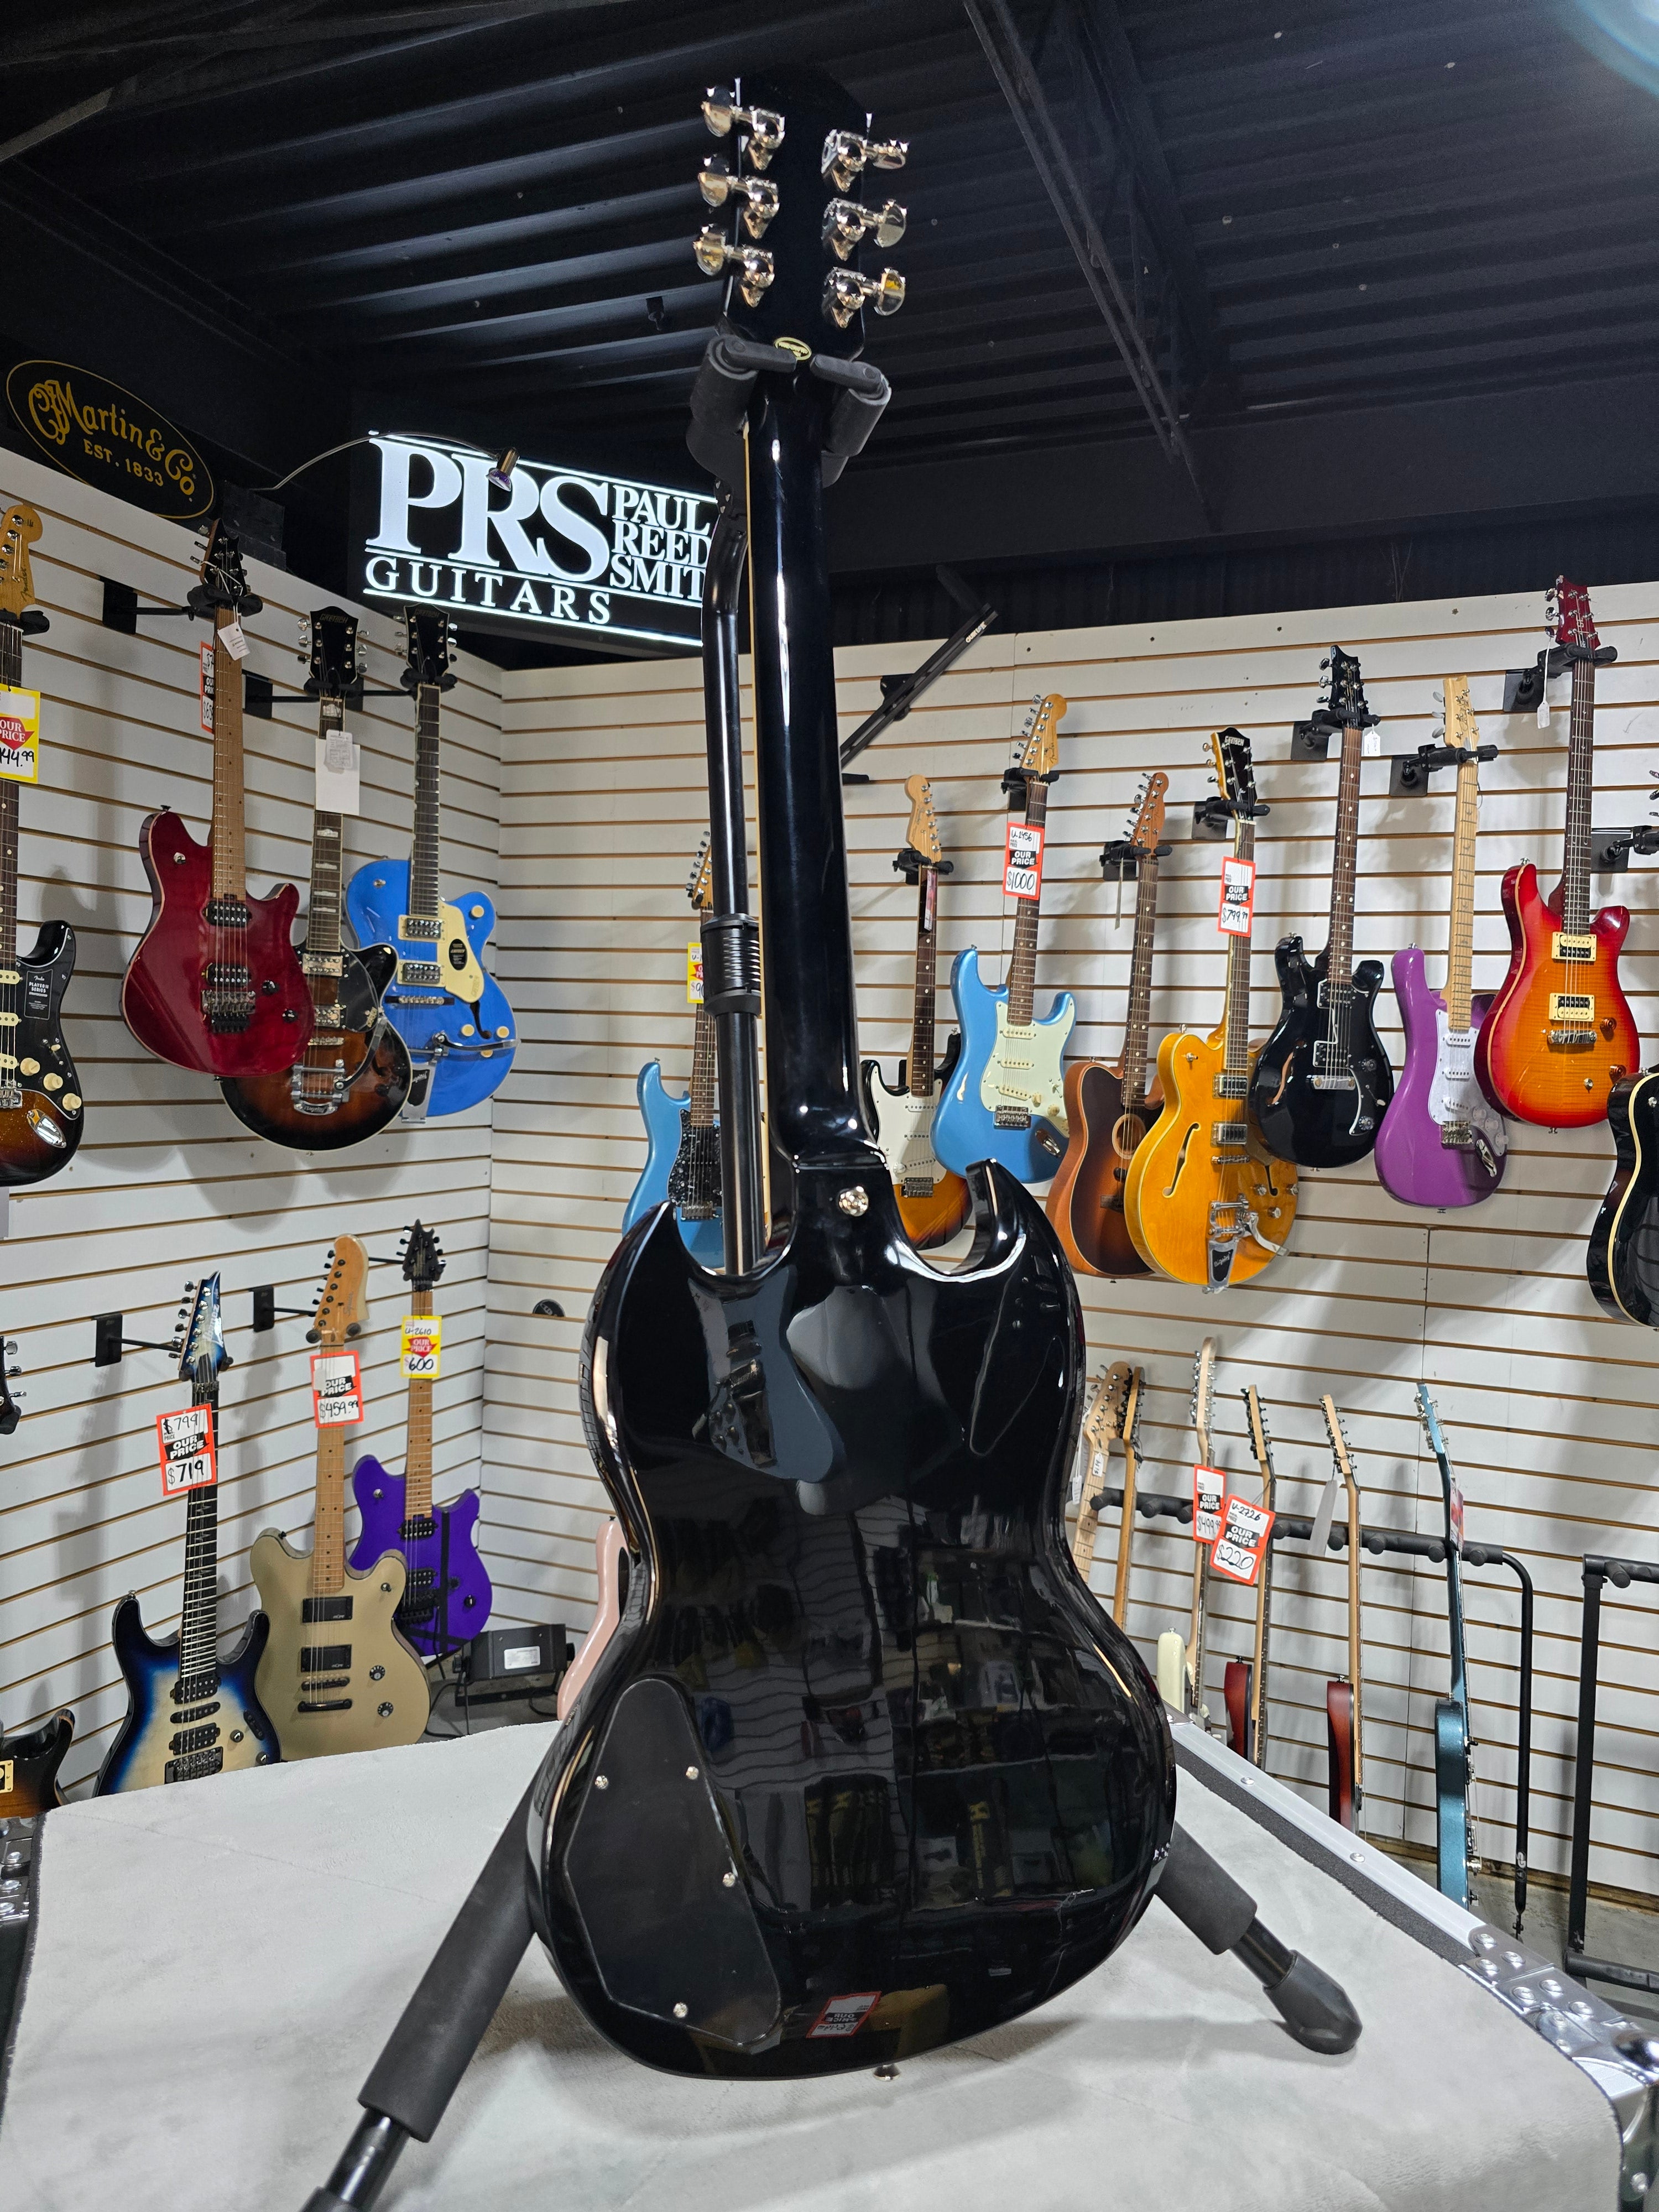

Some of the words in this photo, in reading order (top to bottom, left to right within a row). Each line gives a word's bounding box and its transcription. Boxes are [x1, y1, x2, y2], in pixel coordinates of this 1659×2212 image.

[126, 458, 164, 487] 1833
[366, 438, 609, 582] PRS
[612, 484, 710, 536] PAUL
[611, 519, 712, 568] REED
[609, 554, 706, 601] SMIT
[366, 556, 610, 625] GUITARS
[0, 719, 22, 732] OUR
[1007, 870, 1035, 890] $1000
[1225, 893, 1248, 901] PRICE
[322, 1382, 352, 1396] PRICE
[325, 1377, 346, 1389] OUR
[170, 1440, 204, 1460] PRICE
[173, 1435, 197, 1450] OUR
[168, 1459, 204, 1485] $719
[1199, 1501, 1220, 1510] PRICE
[1225, 1532, 1257, 1547] PRICE
[1230, 1526, 1253, 1538] OUR
[1216, 1545, 1254, 1570] $220
